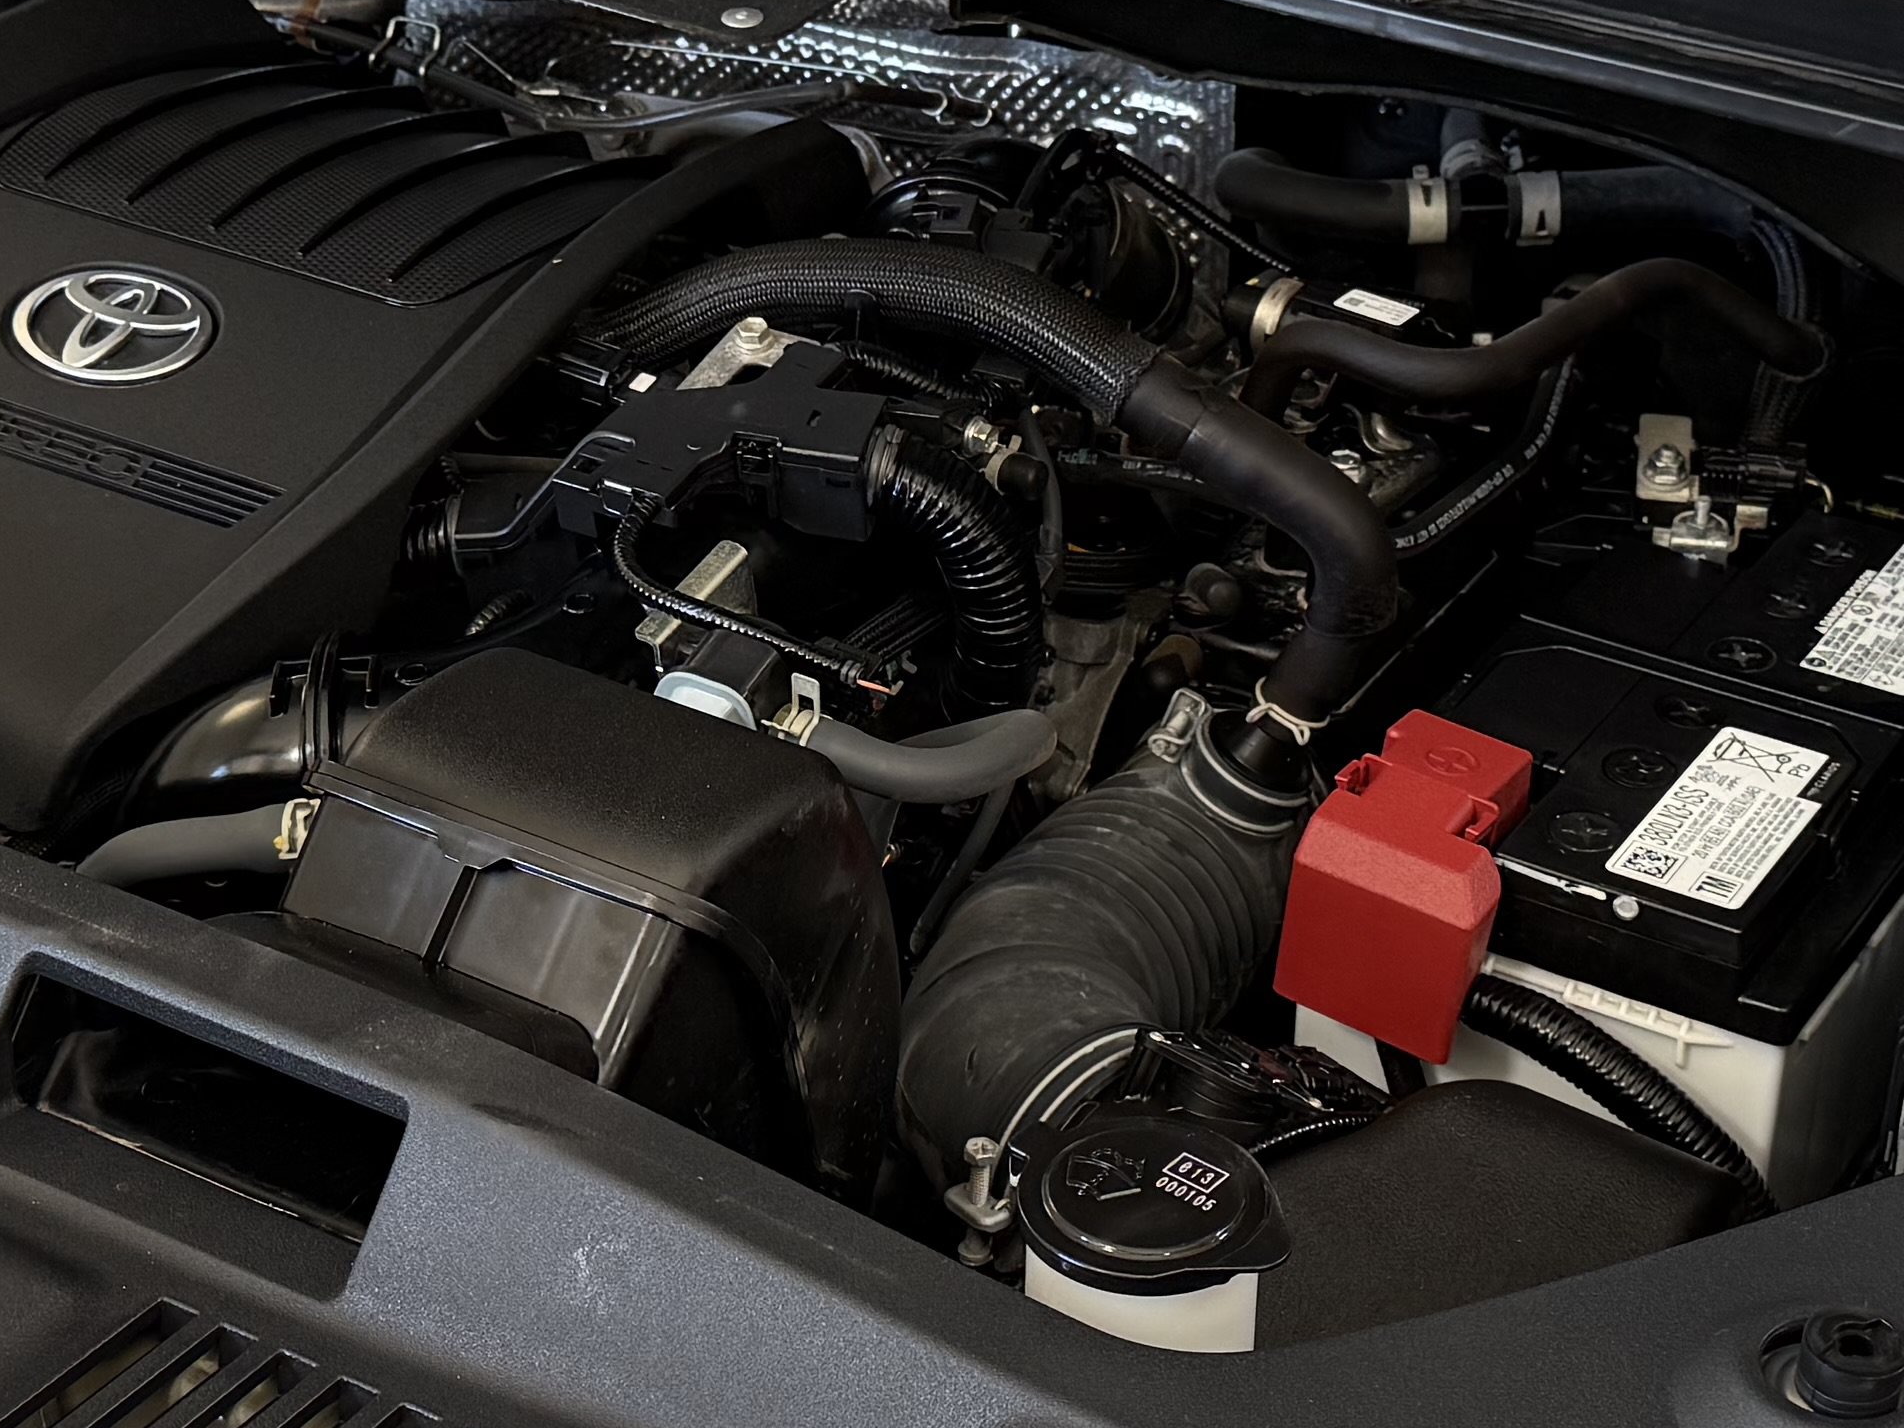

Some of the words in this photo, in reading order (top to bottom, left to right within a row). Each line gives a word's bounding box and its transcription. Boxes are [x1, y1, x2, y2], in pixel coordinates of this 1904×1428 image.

[1788, 763, 1810, 779] Pb
[1813, 762, 1840, 788] CLARIOS
[1696, 875, 1738, 898] TM
[1156, 1177, 1217, 1211] 000105
